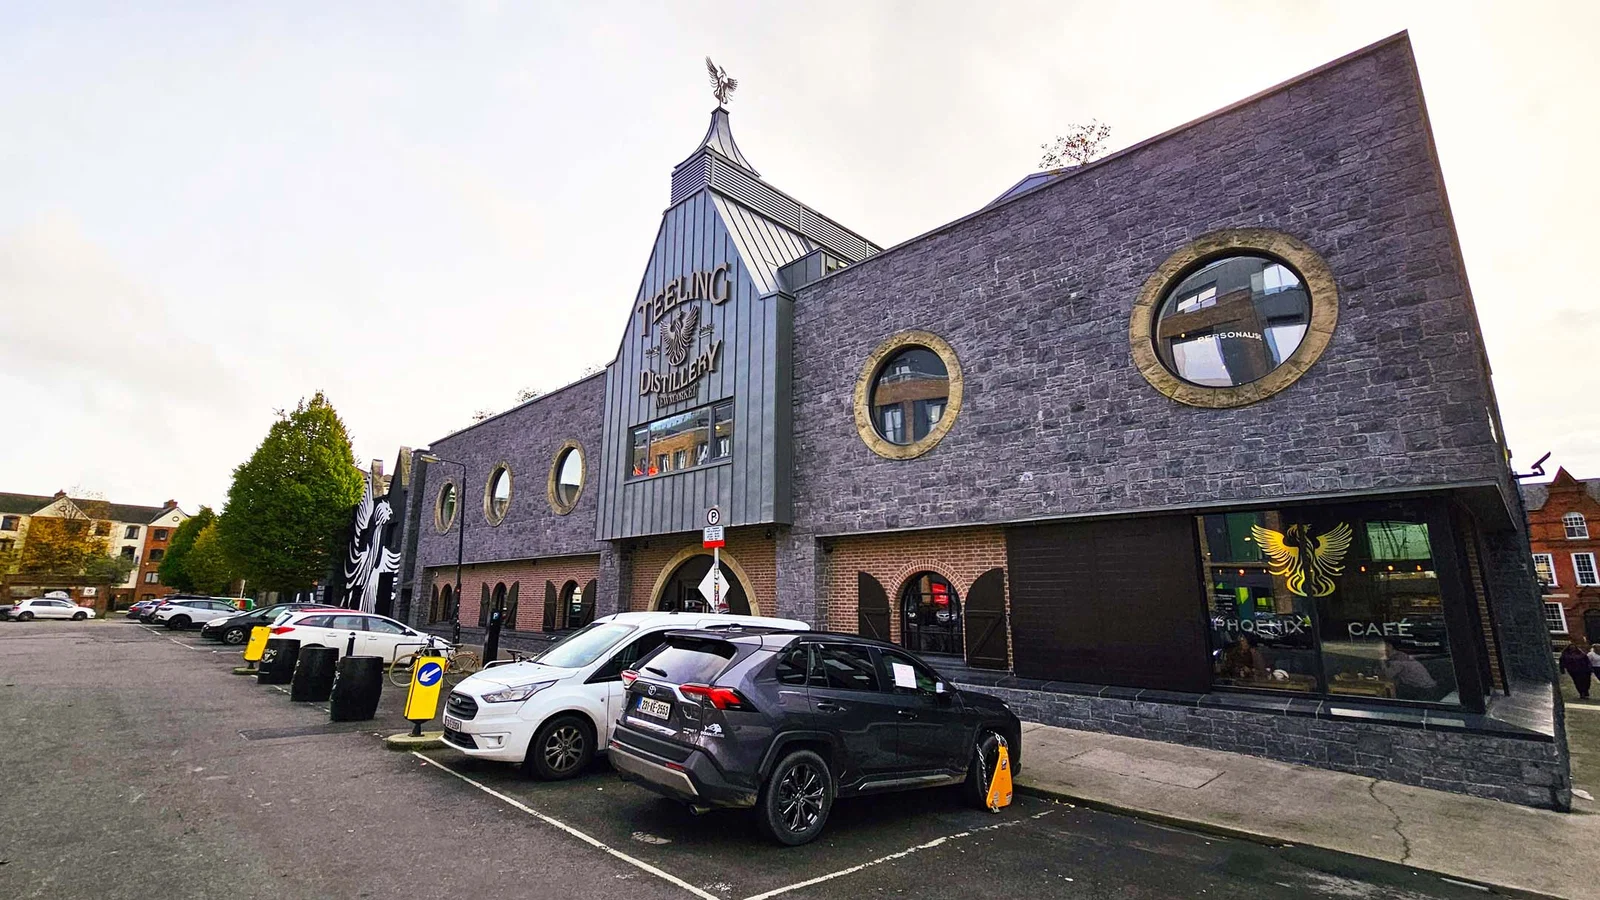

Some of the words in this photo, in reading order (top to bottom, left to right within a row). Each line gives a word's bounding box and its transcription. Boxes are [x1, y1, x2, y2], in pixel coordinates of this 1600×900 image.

[637, 262, 730, 337] TEELING
[639, 339, 722, 396] DISTILLERY
[655, 382, 698, 408] NEWMARKET
[711, 511, 717, 522] P
[1213, 618, 1304, 634] PHOENIX
[1348, 617, 1414, 637] CAFÉ
